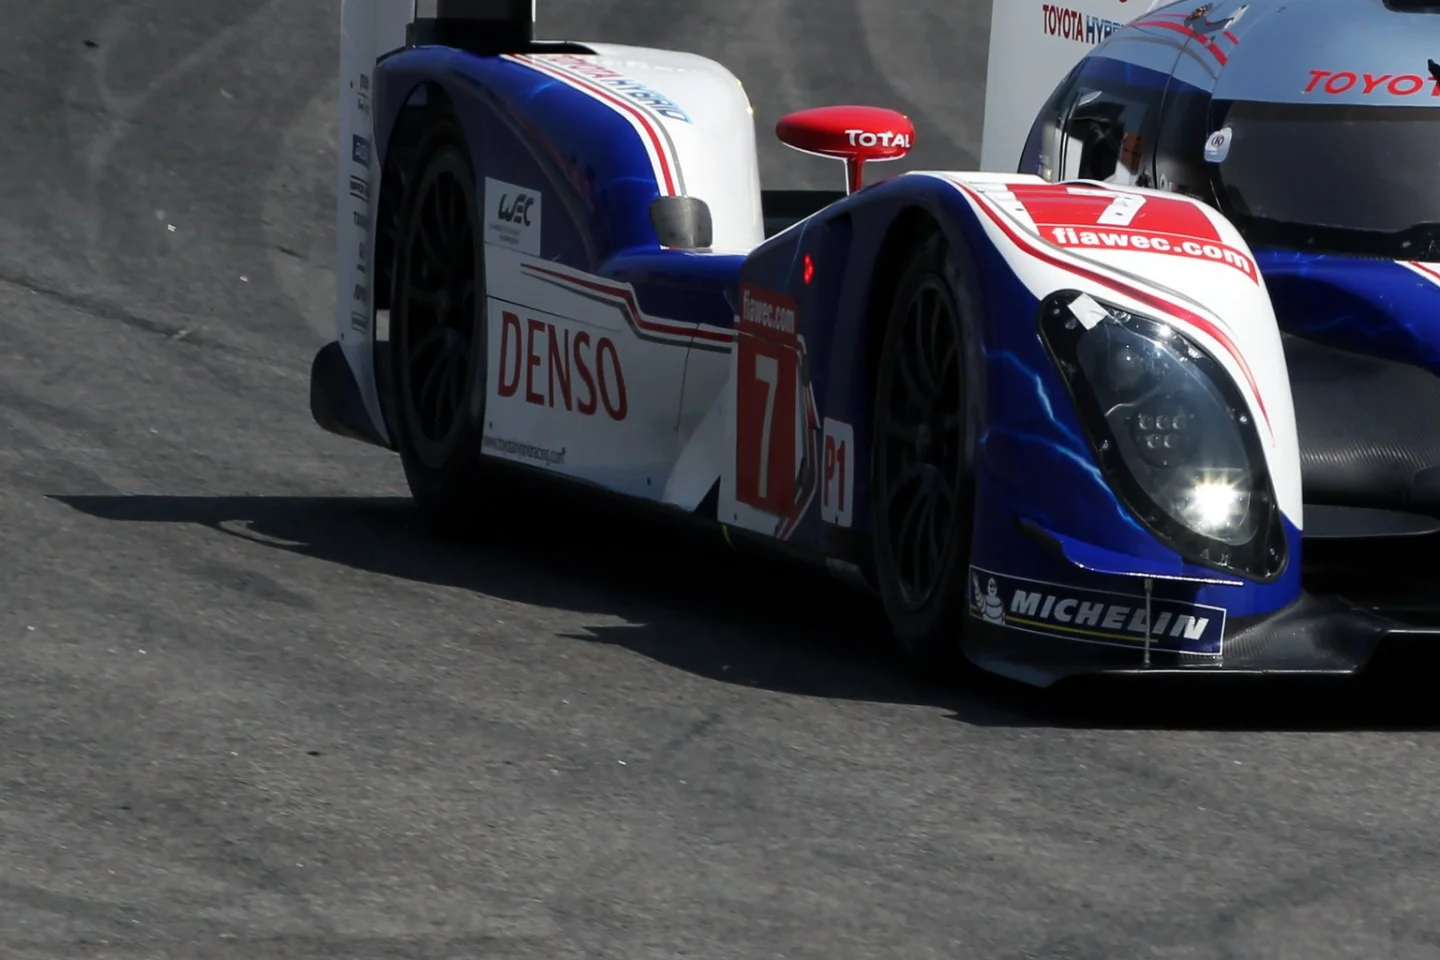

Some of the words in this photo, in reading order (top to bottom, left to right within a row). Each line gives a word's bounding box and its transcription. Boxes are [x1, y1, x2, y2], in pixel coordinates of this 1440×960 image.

[1042, 3, 1085, 43] TOYOTA
[844, 129, 911, 148] TOTAL
[498, 193, 535, 228] WEC
[1066, 187, 1146, 226] 7
[1052, 226, 1251, 274] fiawec.com
[742, 289, 796, 335] fiawec.com
[497, 310, 629, 422] DENSO
[755, 353, 779, 499] 7
[823, 434, 847, 513] P1
[1010, 590, 1209, 641] MICHELIN
